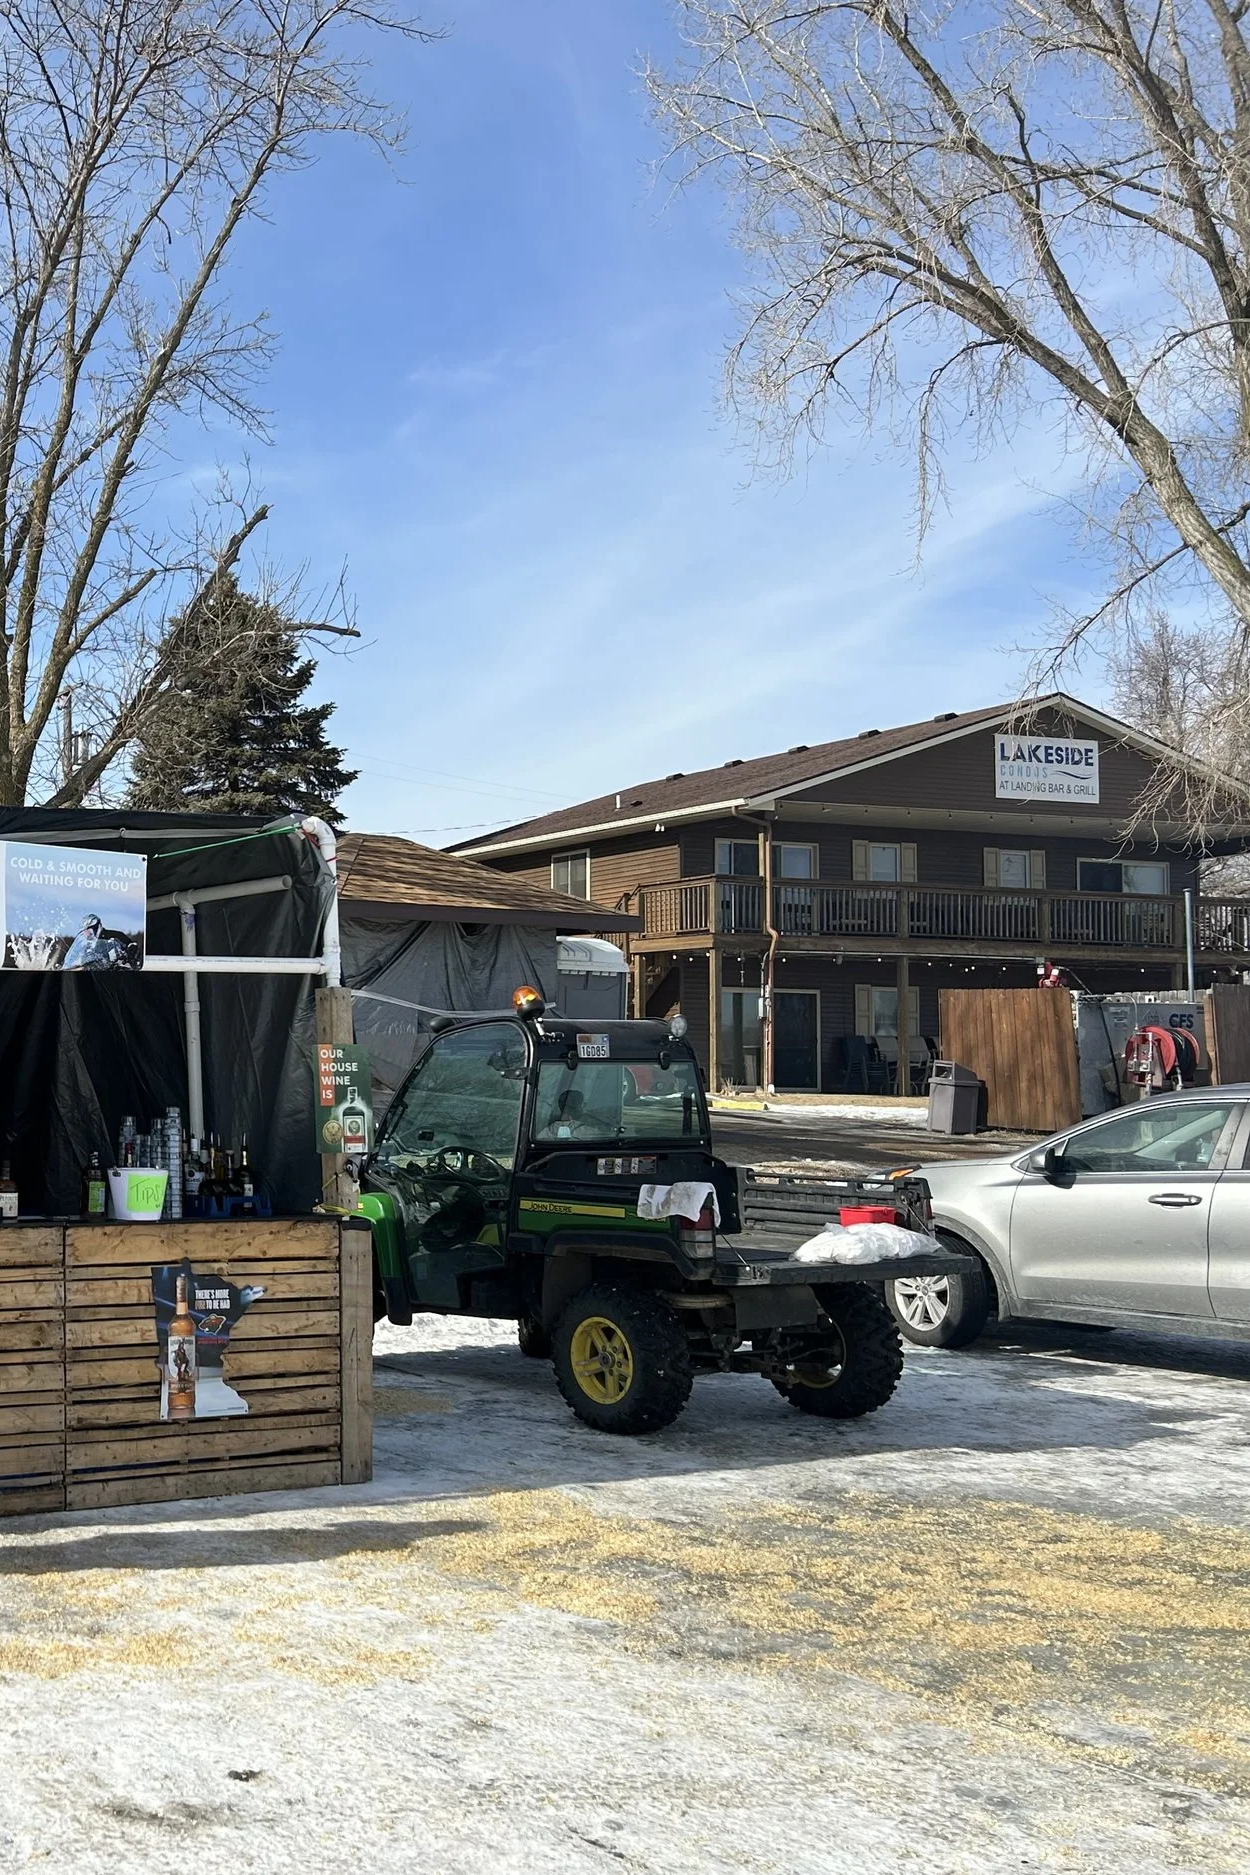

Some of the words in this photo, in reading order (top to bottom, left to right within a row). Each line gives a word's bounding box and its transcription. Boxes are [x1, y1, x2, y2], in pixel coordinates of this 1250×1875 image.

[1000, 742, 1094, 766] LAKESIDE
[999, 780, 1008, 791] AT
[1048, 783, 1064, 794] BAR
[1067, 784, 1071, 794] &
[1073, 785, 1096, 796] GRILL
[10, 856, 44, 871] COLD
[46, 859, 56, 872] &
[59, 860, 112, 878] SMOOTH
[116, 866, 141, 879] AND
[18, 872, 74, 888] WAITING
[77, 876, 98, 890] FOR
[102, 879, 129, 892] YOU
[320, 1049, 343, 1059] OUR
[321, 1063, 358, 1072] HOUSE
[321, 1076, 350, 1085] WINE
[322, 1089, 333, 1099] IS
